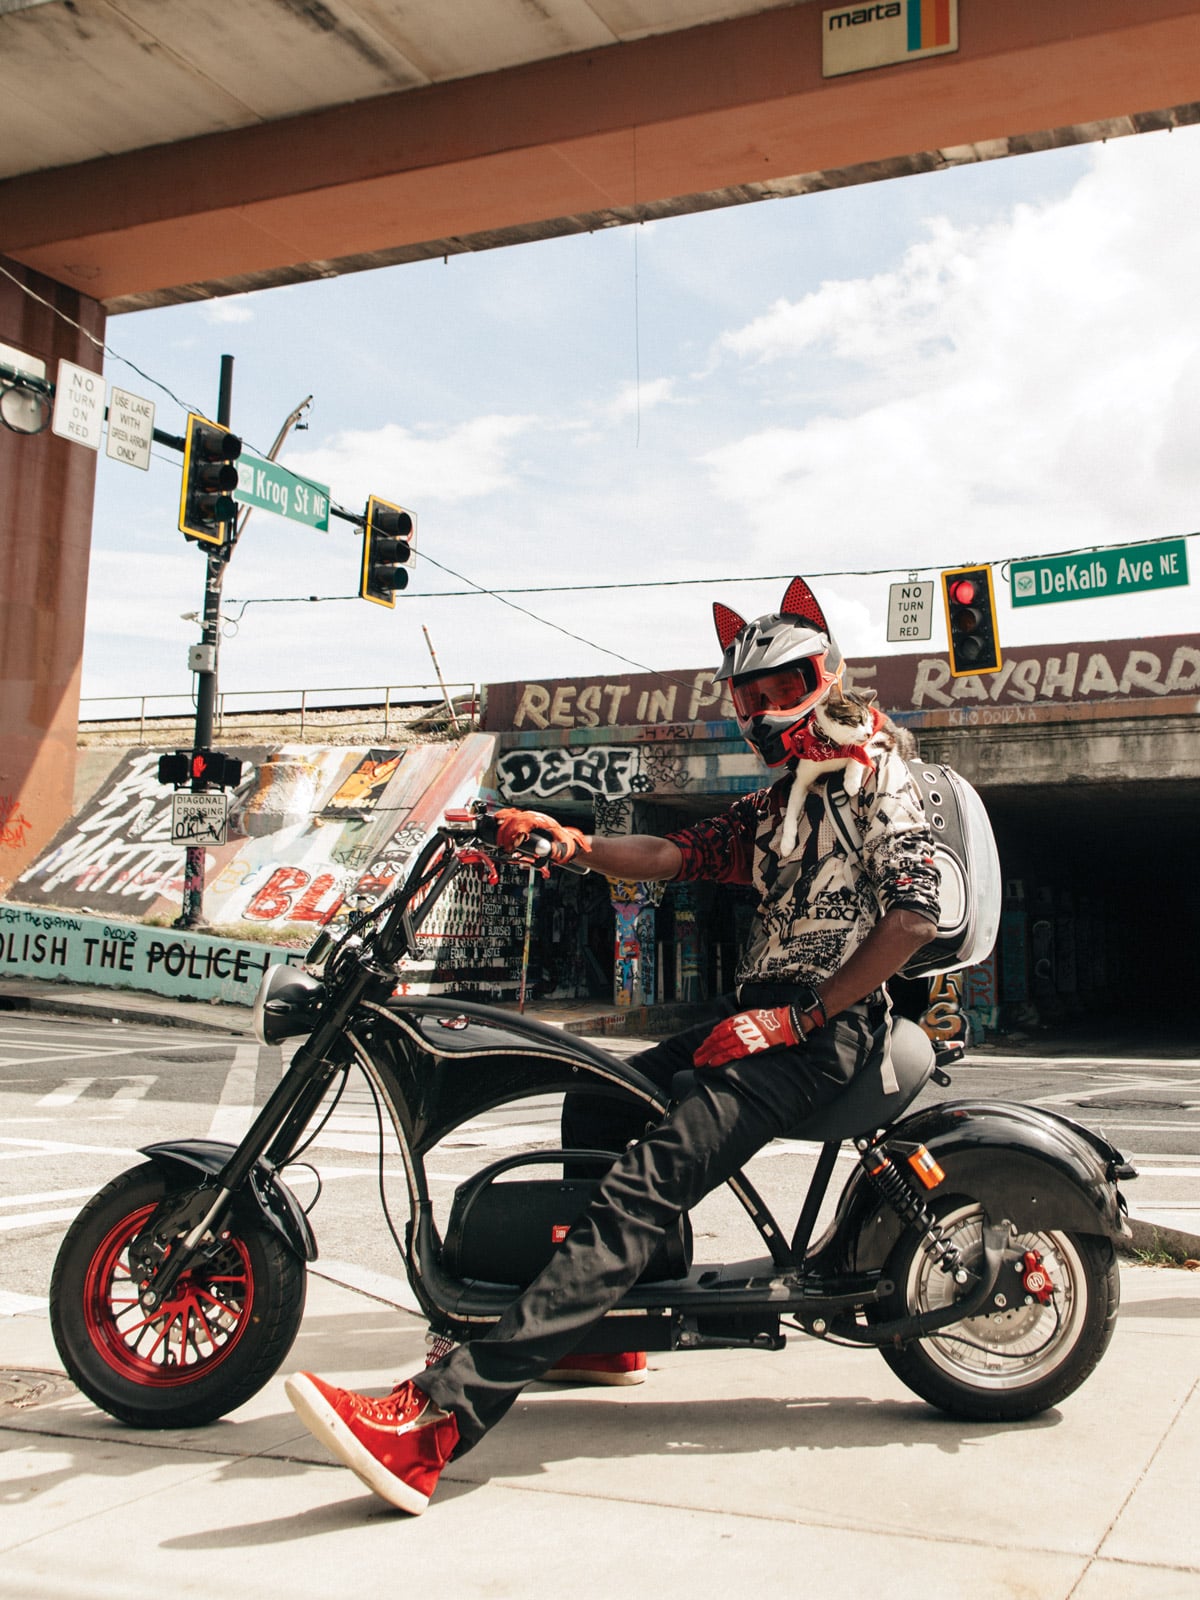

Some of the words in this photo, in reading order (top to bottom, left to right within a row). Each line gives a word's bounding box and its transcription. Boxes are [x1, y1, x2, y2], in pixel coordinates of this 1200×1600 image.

[828, 2, 901, 31] marta
[73, 373, 94, 392] NO
[69, 389, 96, 408] TURN
[114, 394, 129, 410] USE
[131, 399, 151, 418] LANE
[72, 407, 88, 421] ON
[119, 413, 141, 430] WITH
[68, 421, 89, 438] RED
[111, 427, 128, 441] GREEN
[129, 435, 148, 450] ARROW
[116, 446, 137, 461] ONLY
[256, 469, 289, 516] Krog
[294, 484, 309, 515] St
[313, 494, 326, 518] NE
[1040, 561, 1108, 595] DeKalb
[1116, 557, 1153, 585] Ave
[1159, 553, 1179, 576] NE
[901, 586, 922, 599] NO
[897, 601, 924, 611] TURN
[902, 614, 917, 624] ON
[899, 626, 919, 637] RED
[910, 646, 1200, 708] RAYSHARD
[513, 683, 631, 729] REST
[636, 684, 678, 723] IN
[176, 796, 224, 805] DIAGONAL
[176, 807, 224, 816] CROSSING
[175, 822, 196, 838] OK
[83, 937, 137, 971] THE
[147, 941, 251, 984] POLICE
[733, 1014, 770, 1054] FOX
